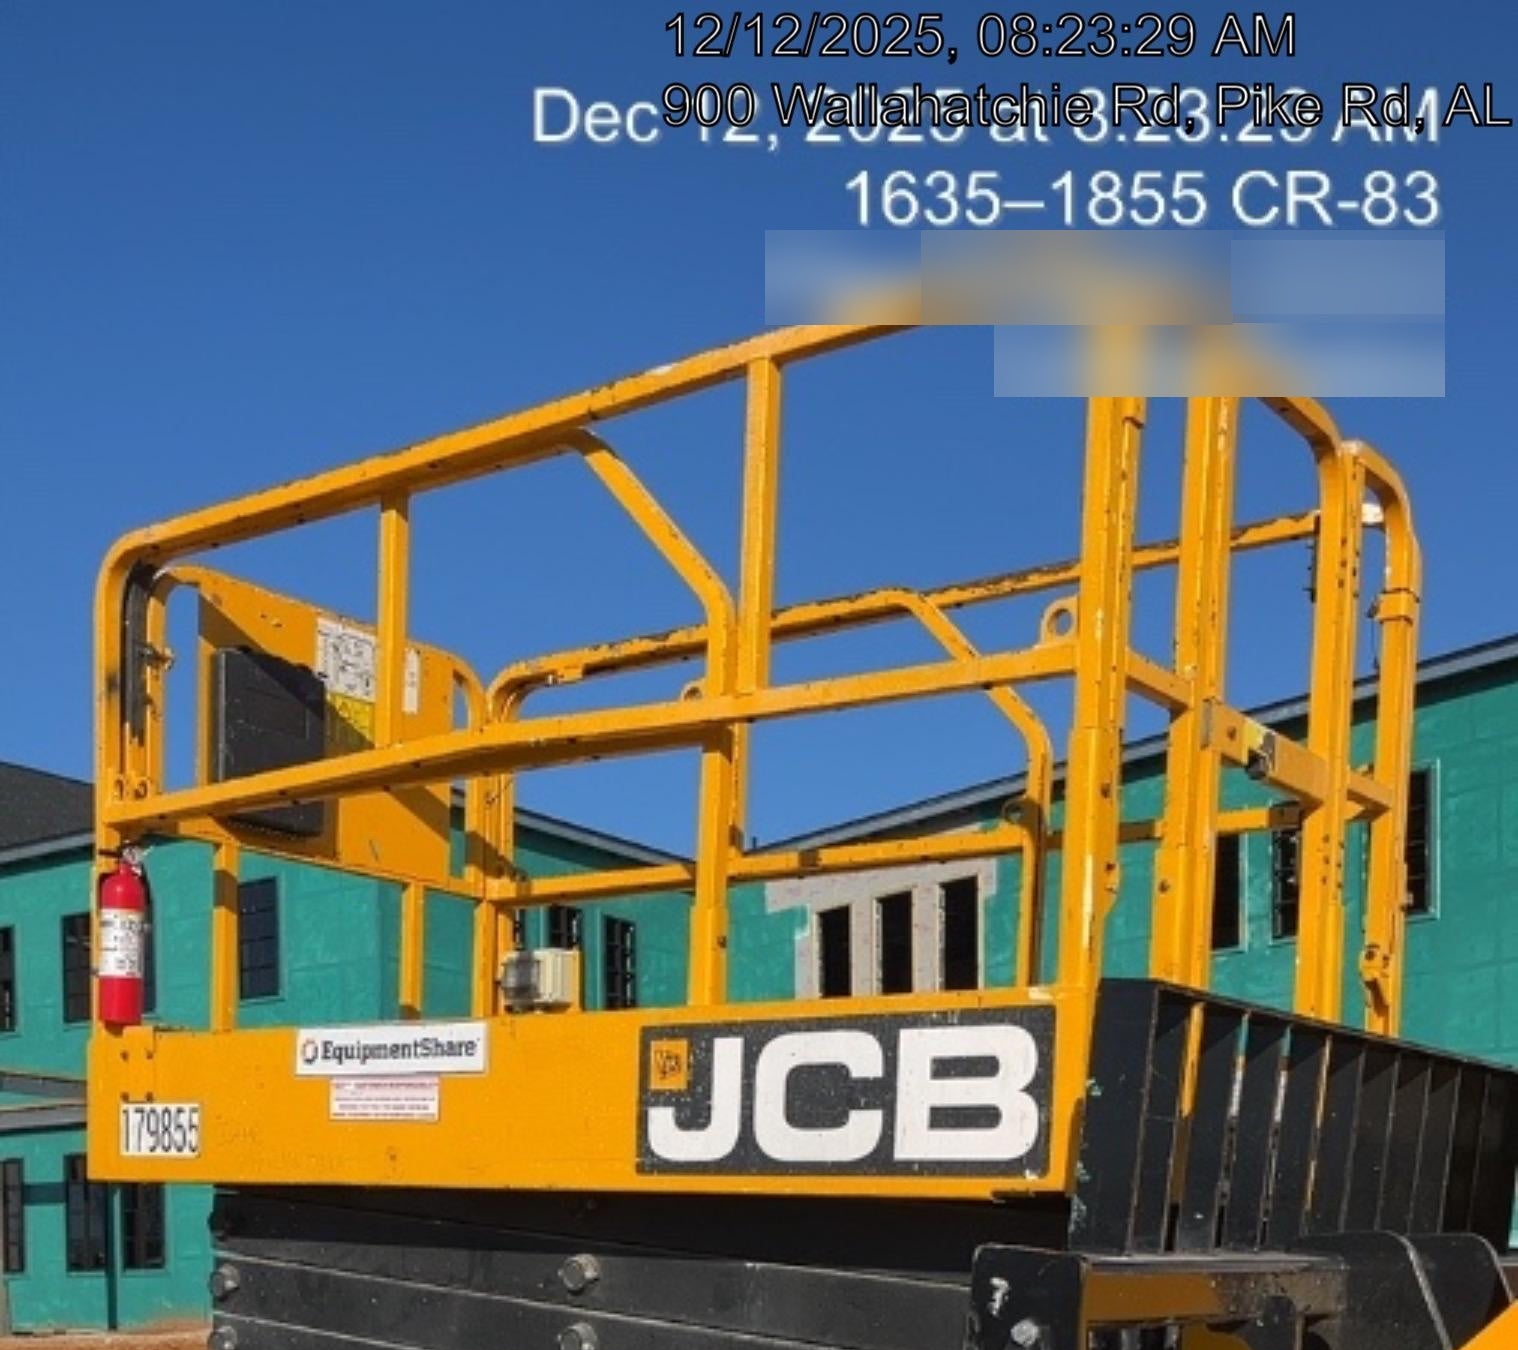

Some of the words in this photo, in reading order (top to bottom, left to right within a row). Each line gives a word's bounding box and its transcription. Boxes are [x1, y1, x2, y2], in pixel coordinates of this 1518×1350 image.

[321, 1037, 478, 1066] EquipmentShare
[646, 1024, 1038, 1163] JCB
[122, 1106, 199, 1153] 179855
